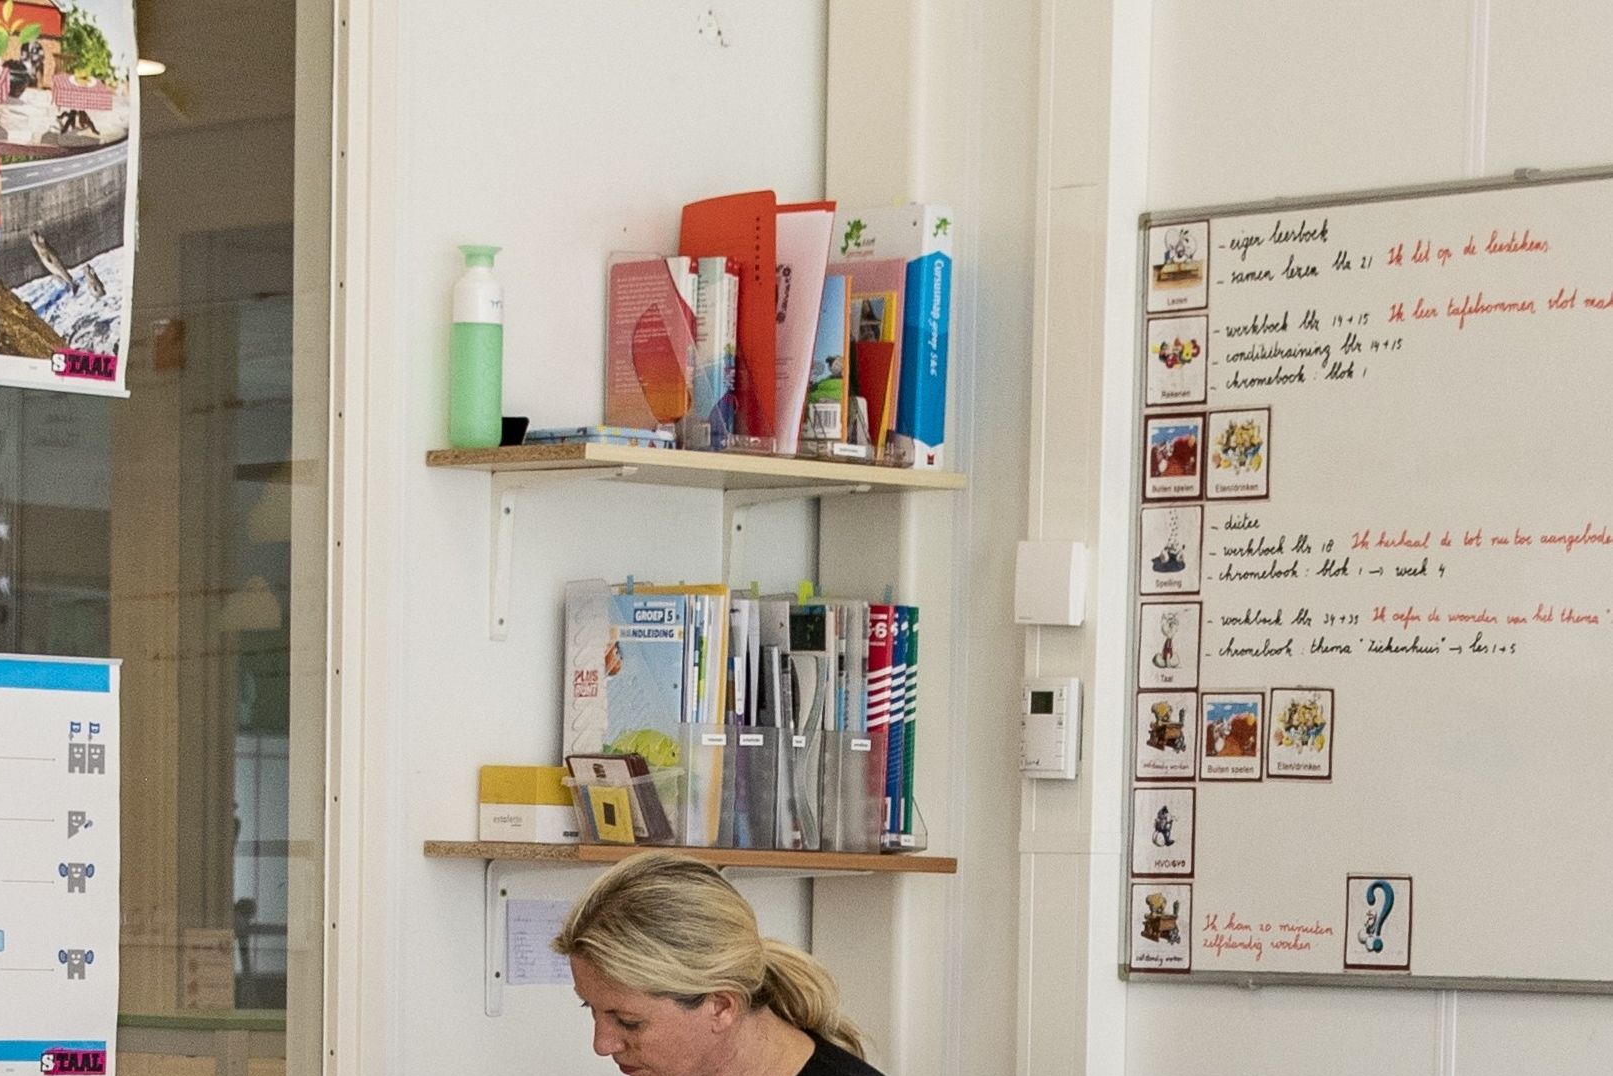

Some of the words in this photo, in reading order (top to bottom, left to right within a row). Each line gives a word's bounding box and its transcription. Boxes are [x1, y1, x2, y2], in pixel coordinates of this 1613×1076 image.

[1269, 218, 1329, 243] leesboek
[1387, 243, 1403, 265] Ik
[1411, 239, 1431, 263] let
[1437, 248, 1452, 266] op
[1463, 235, 1477, 256] de
[1231, 269, 1275, 284] samen
[930, 259, 945, 319] Cursusmap
[1388, 303, 1404, 322] Ik
[1352, 529, 1370, 549] Ik
[1440, 530, 1451, 547] de
[1463, 528, 1483, 547] tot
[1316, 557, 1350, 577] blok
[1395, 557, 1428, 577] week
[634, 610, 663, 622] GROEP
[1372, 606, 1387, 622] Ik
[1428, 607, 1440, 623] de
[1230, 765, 1254, 774] spelen
[1202, 914, 1218, 931] Ik
[1224, 912, 1252, 932] kan
[1279, 922, 1334, 935] minuten
[1202, 934, 1263, 961] zelfstandig
[1269, 935, 1312, 950] werken
[41, 1053, 103, 1072] STAAL
